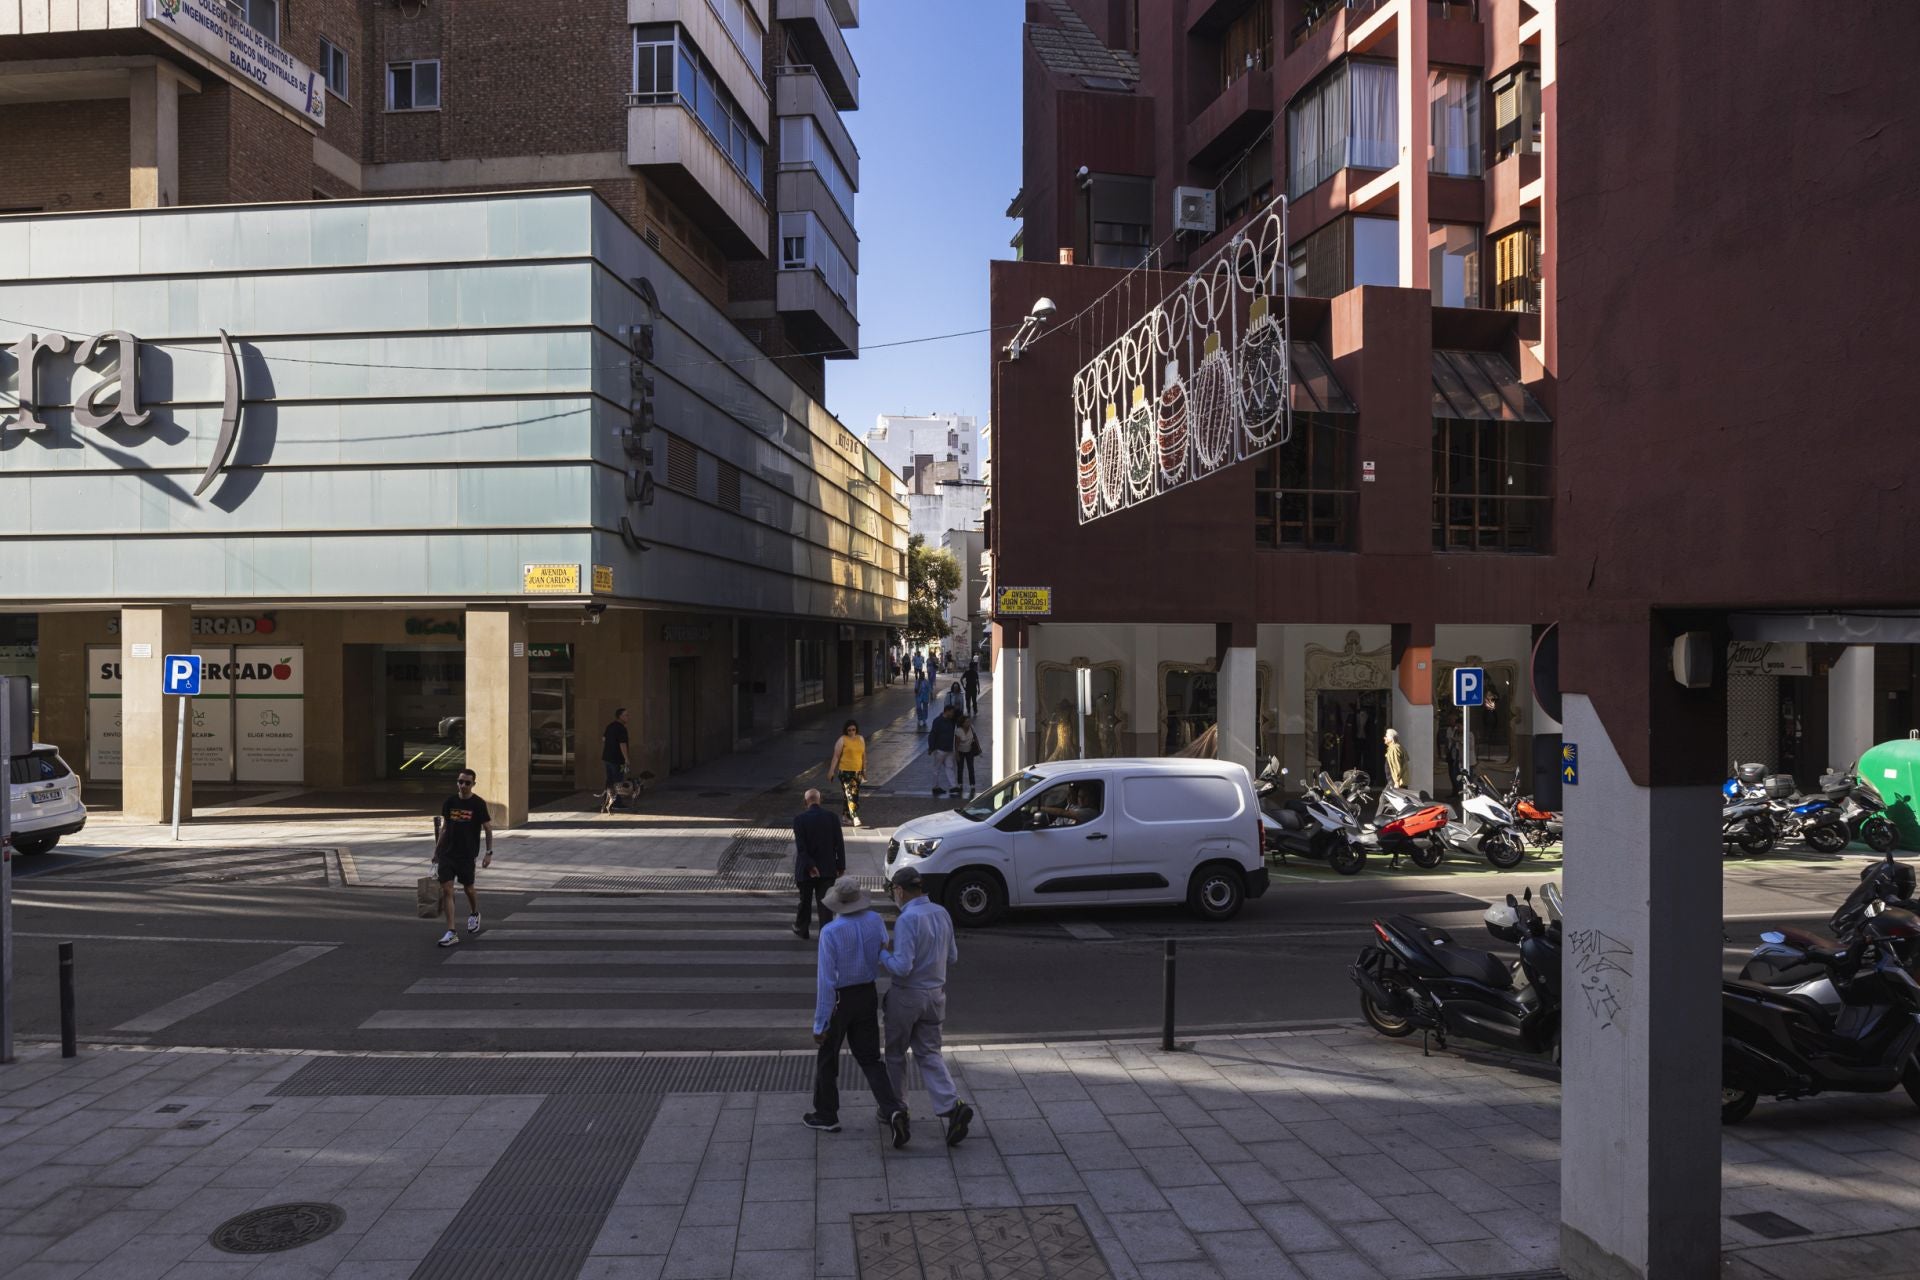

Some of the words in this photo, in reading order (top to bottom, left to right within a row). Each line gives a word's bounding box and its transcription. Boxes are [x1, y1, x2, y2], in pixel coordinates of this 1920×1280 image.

[182, 2, 224, 39] INGENIEROS
[256, 52, 299, 89] INDUSTRIALES
[299, 80, 307, 95] DE
[228, 15, 253, 42] OFICIAL
[255, 33, 263, 47] DE
[264, 39, 289, 63] PERITOS
[289, 55, 294, 69] E
[230, 50, 268, 86] BADAJOZ
[529, 576, 545, 584] JUAN
[546, 576, 570, 584] CARLOS
[541, 568, 567, 576] AVENIDA
[171, 659, 193, 690] P
[1461, 673, 1477, 701] P
